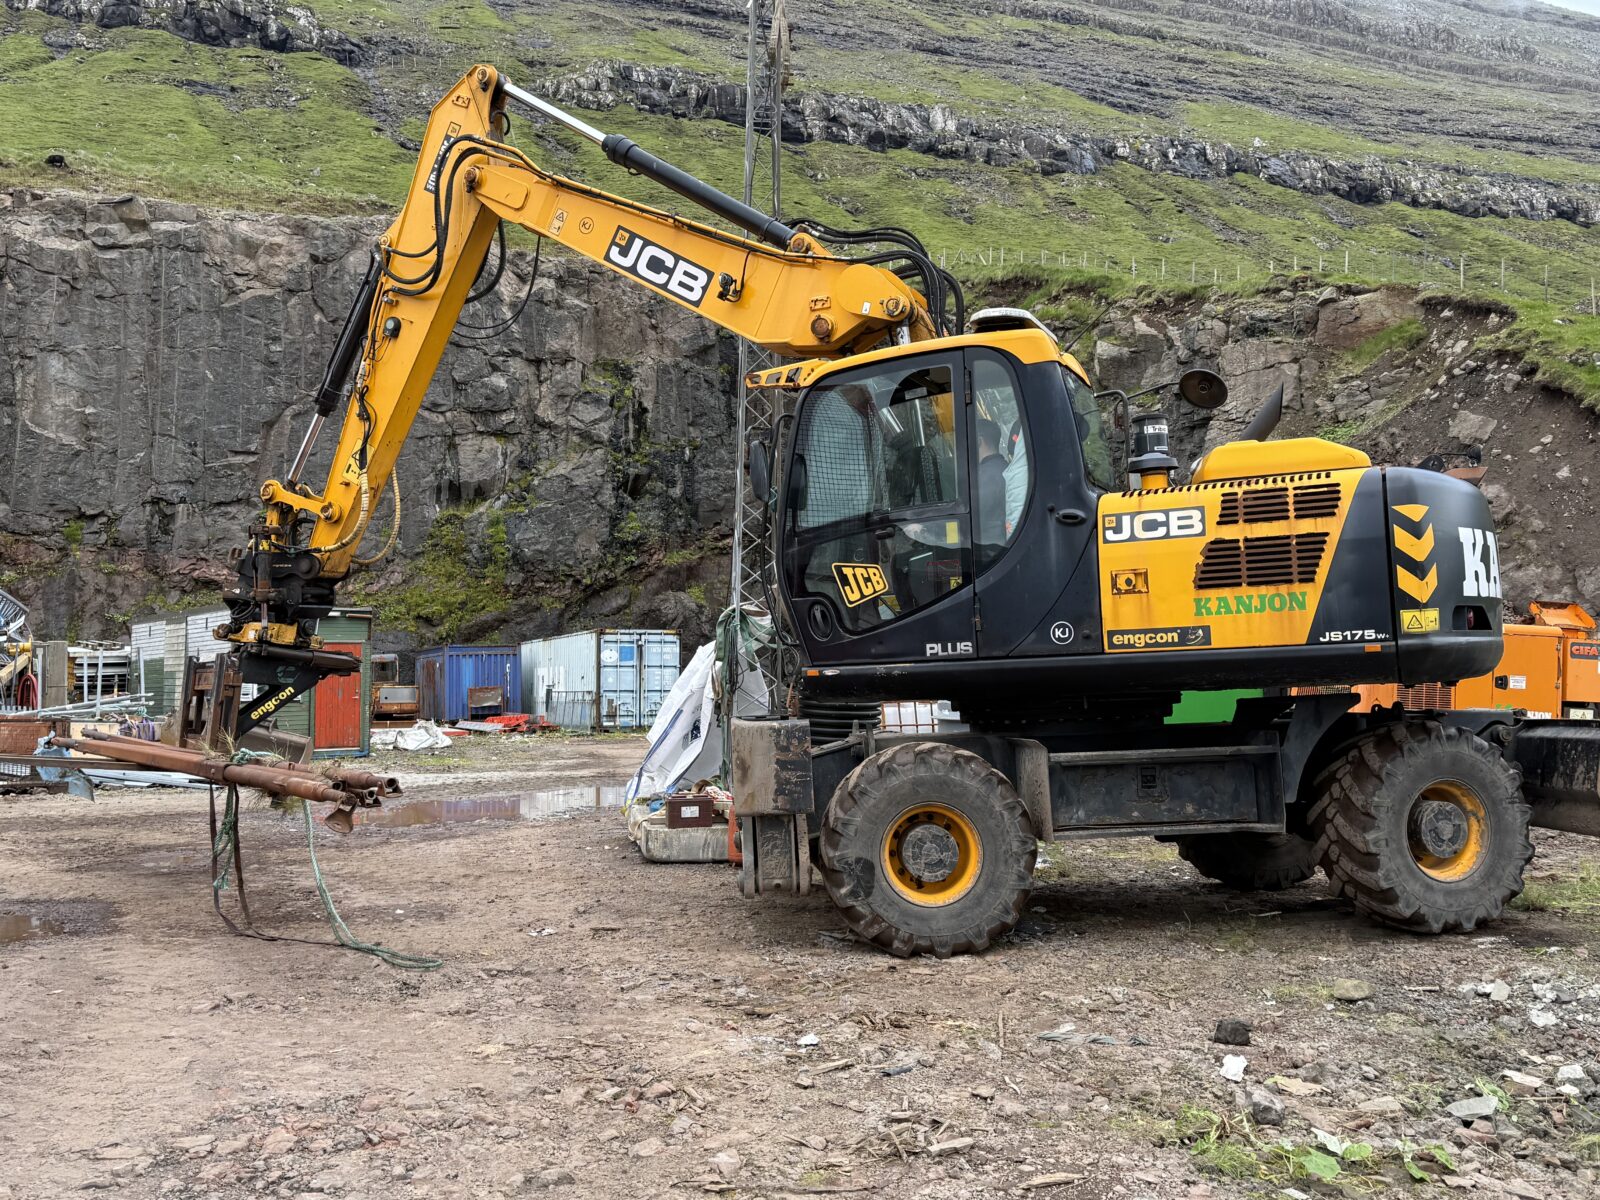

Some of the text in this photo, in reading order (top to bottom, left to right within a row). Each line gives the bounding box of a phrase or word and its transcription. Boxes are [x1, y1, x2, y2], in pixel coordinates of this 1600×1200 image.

[609, 237, 708, 302] JCB
[1105, 509, 1203, 541] JCB
[842, 567, 885, 601] JCB
[1194, 591, 1307, 616] KANJON
[1055, 628, 1069, 638] KJ
[1112, 630, 1179, 647] engcon
[925, 641, 973, 657] PLUS
[1571, 645, 1599, 656] CIFA
[250, 686, 295, 720] engcon
[1526, 711, 1552, 719] NJON
